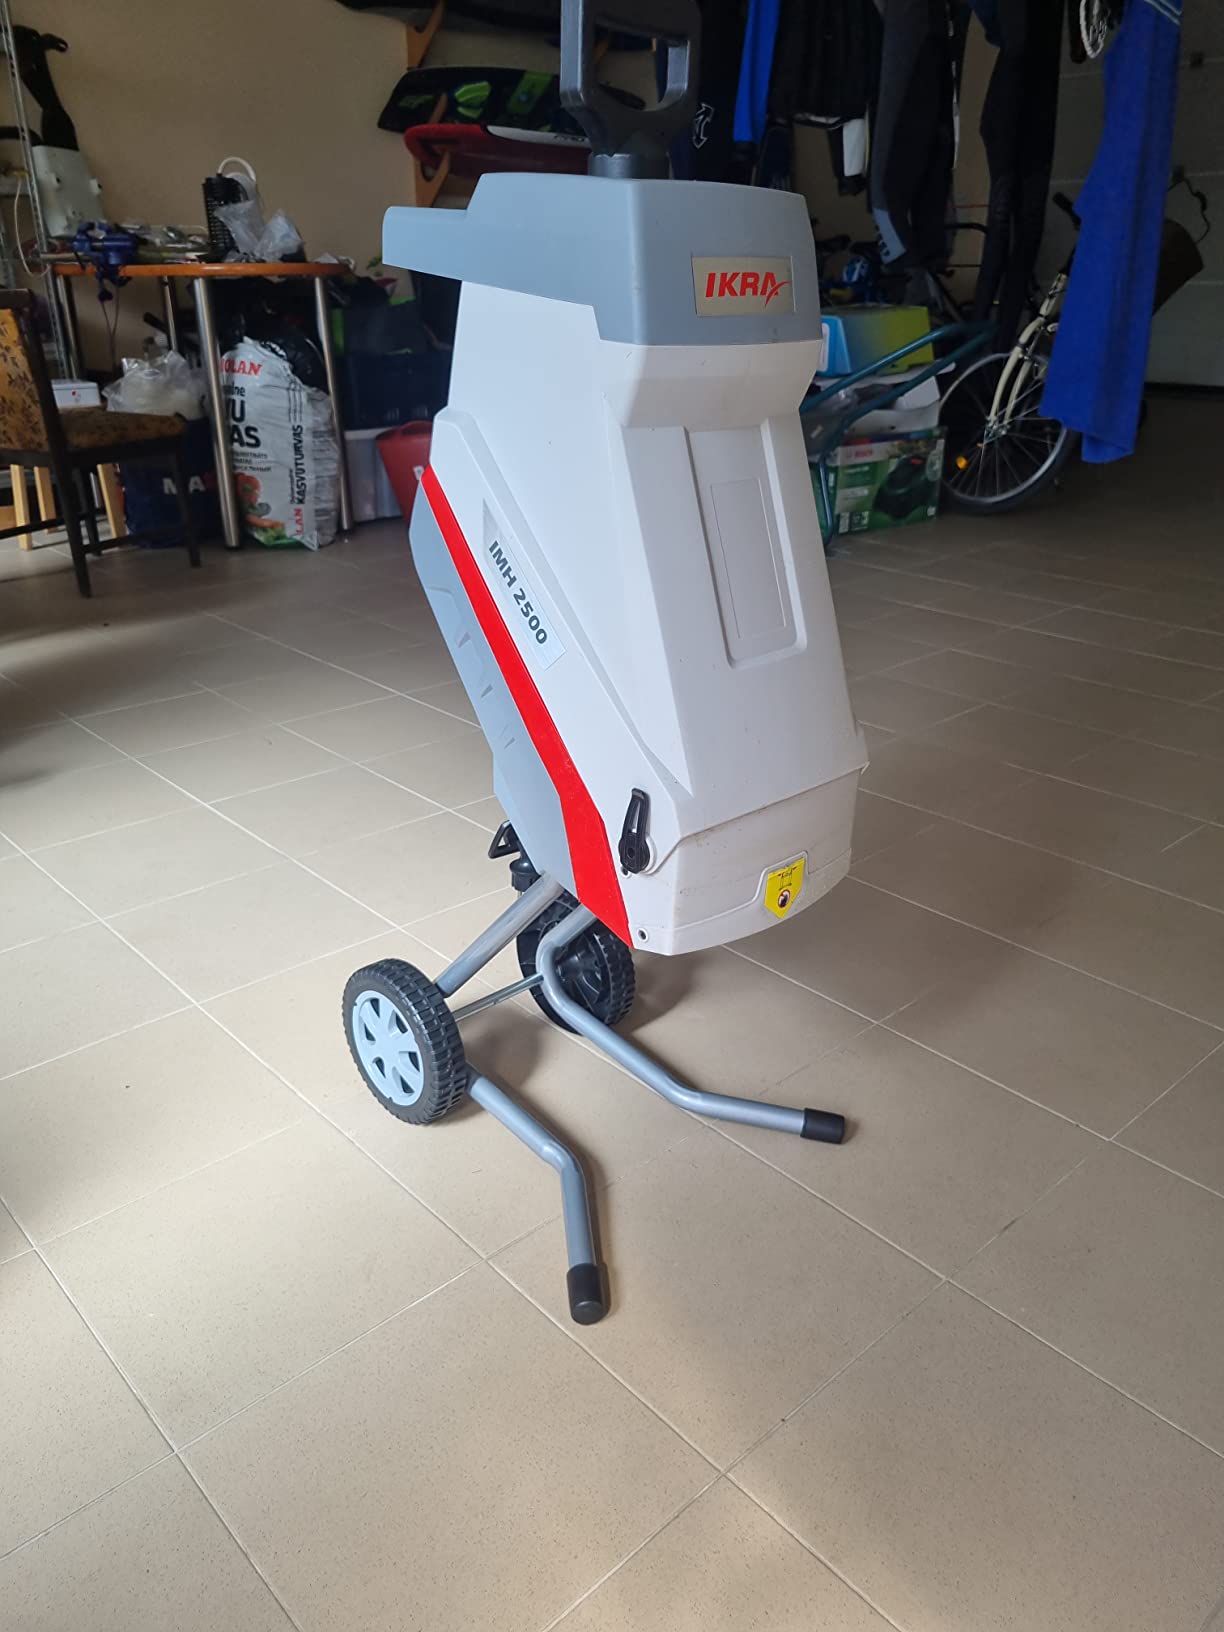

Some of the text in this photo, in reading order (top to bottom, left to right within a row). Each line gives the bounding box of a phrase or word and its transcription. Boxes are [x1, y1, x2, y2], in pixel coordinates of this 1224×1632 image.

[705, 271, 783, 301] IKRA
[488, 540, 547, 644] IMH 2500
